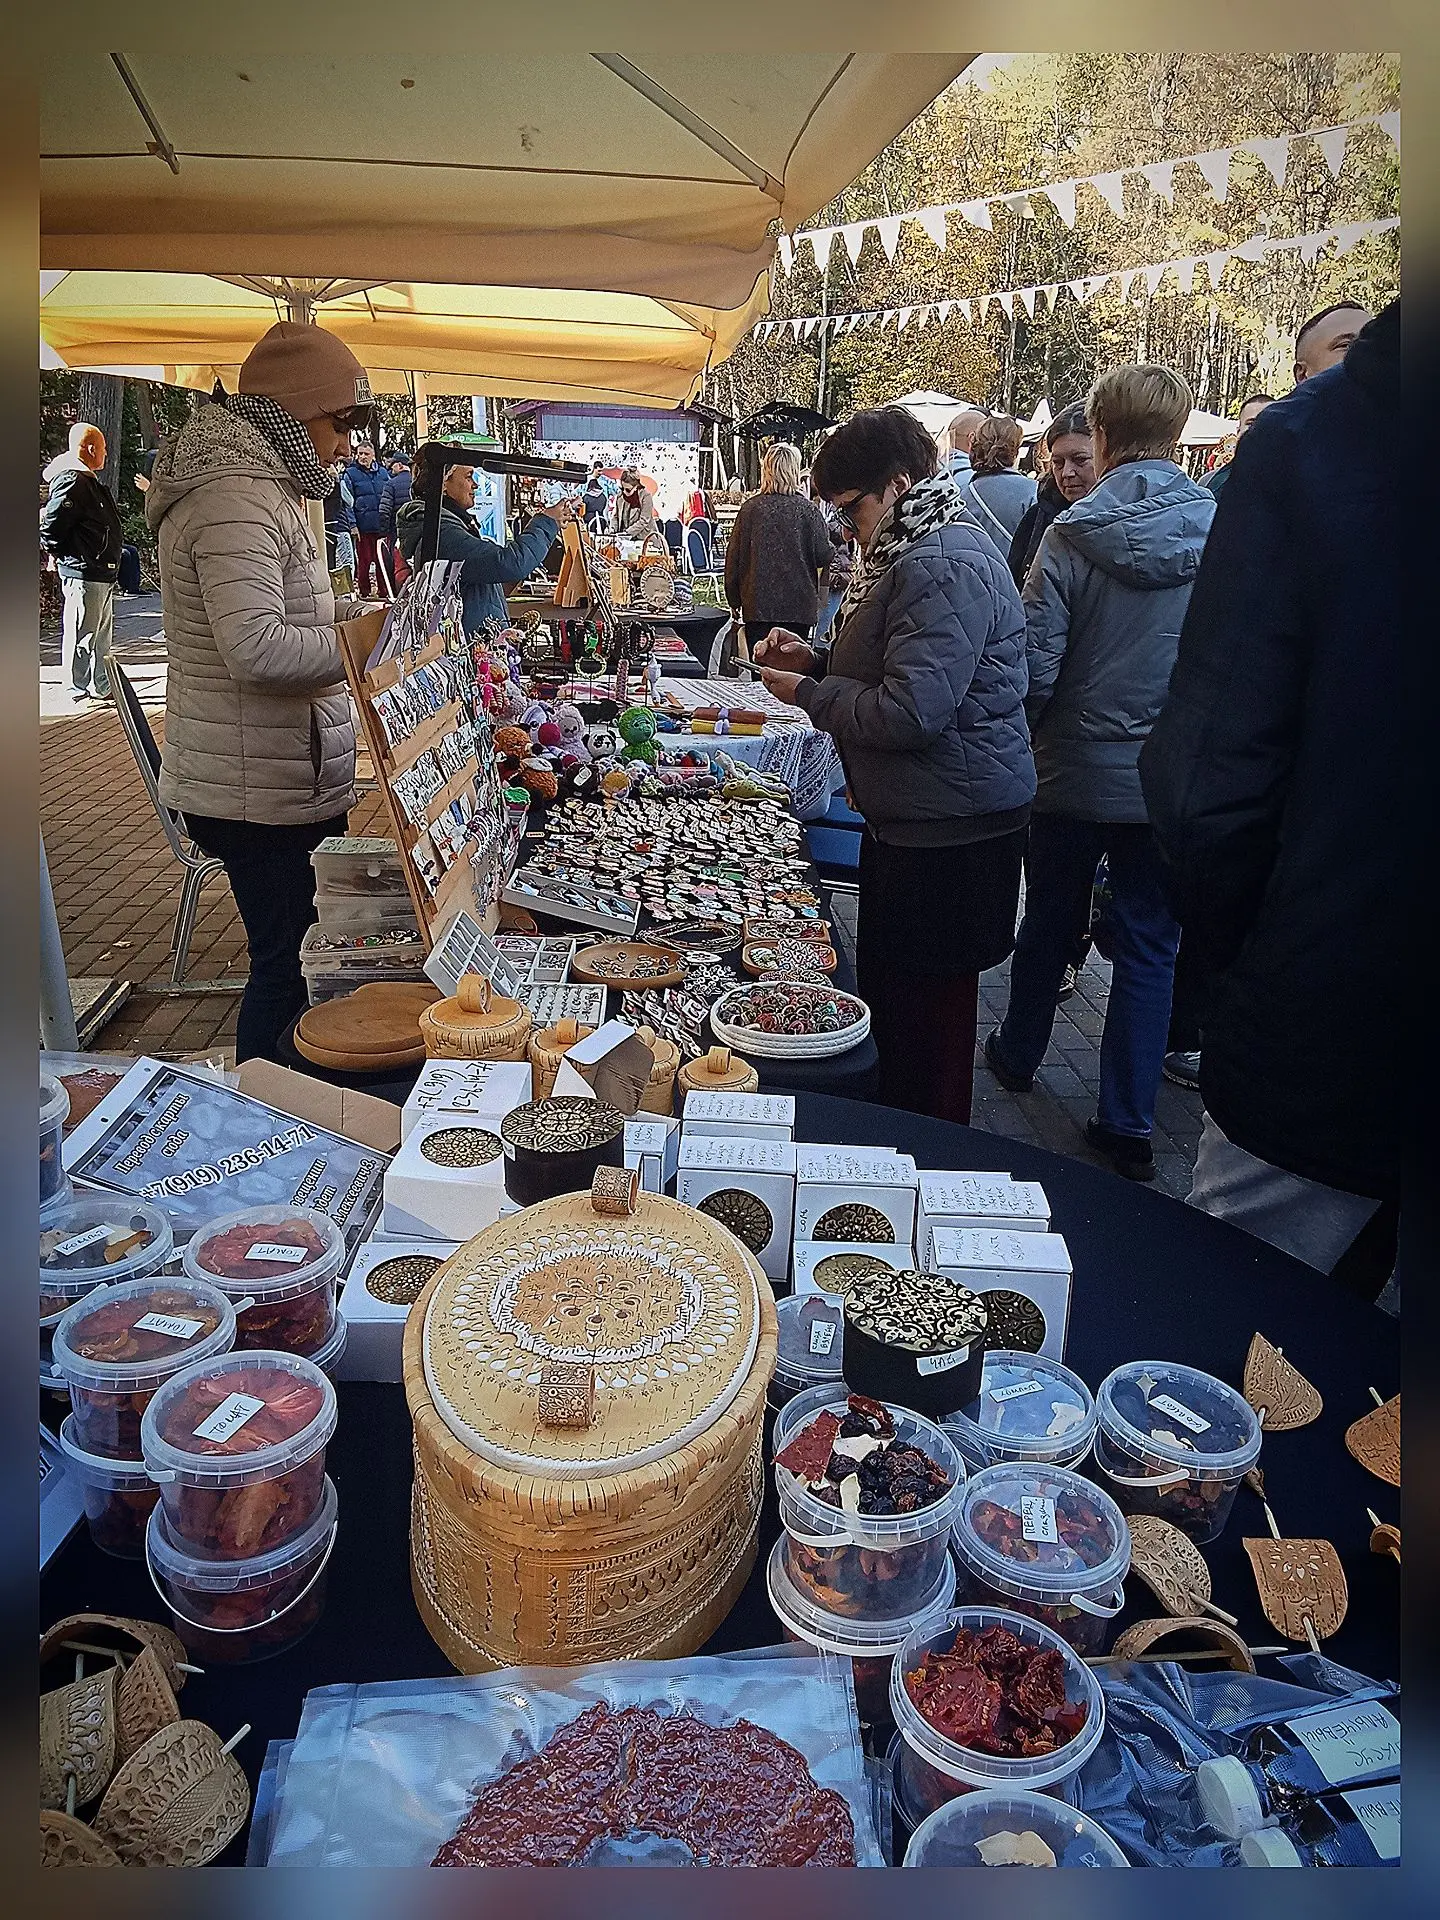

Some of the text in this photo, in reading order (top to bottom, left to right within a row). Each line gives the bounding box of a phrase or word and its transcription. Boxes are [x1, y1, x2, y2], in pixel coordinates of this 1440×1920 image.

[112, 1093, 190, 1175] Перевод с карты
[161, 1129, 189, 1157] сюда
[140, 1123, 318, 1198] +7(919) 236-14-71
[309, 1185, 337, 1215] удет
[330, 1166, 371, 1229] Алексеевич
[257, 1246, 299, 1259] ТОМАТ
[146, 1316, 187, 1337] ТОМАТ
[208, 1402, 250, 1435] ТОМАТ
